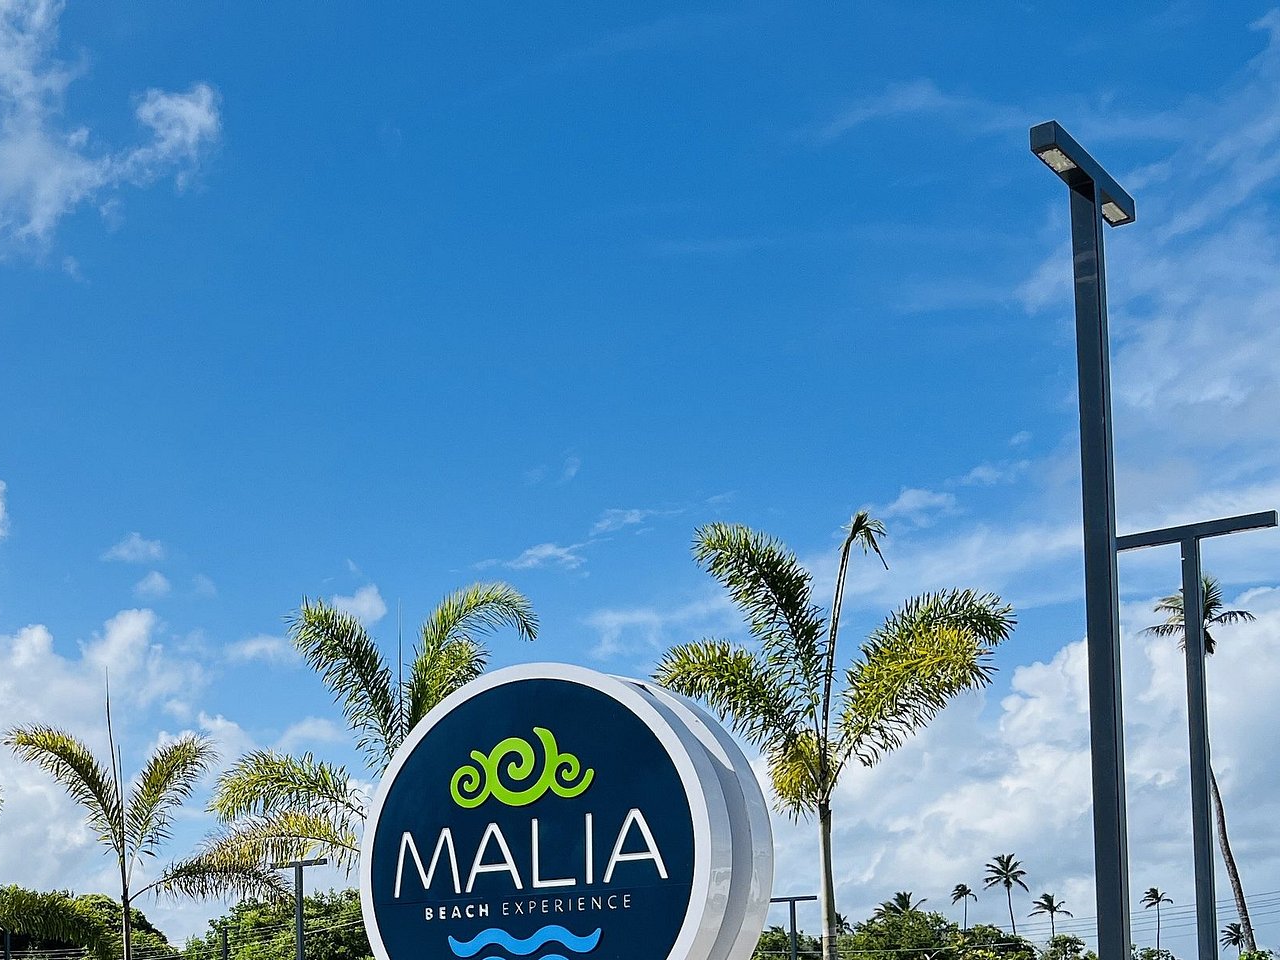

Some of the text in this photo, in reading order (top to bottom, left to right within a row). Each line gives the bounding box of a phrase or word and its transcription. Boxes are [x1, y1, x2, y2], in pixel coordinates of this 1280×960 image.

[394, 808, 669, 899] MALIA
[424, 894, 632, 921] BEACH EXPERIENCE
